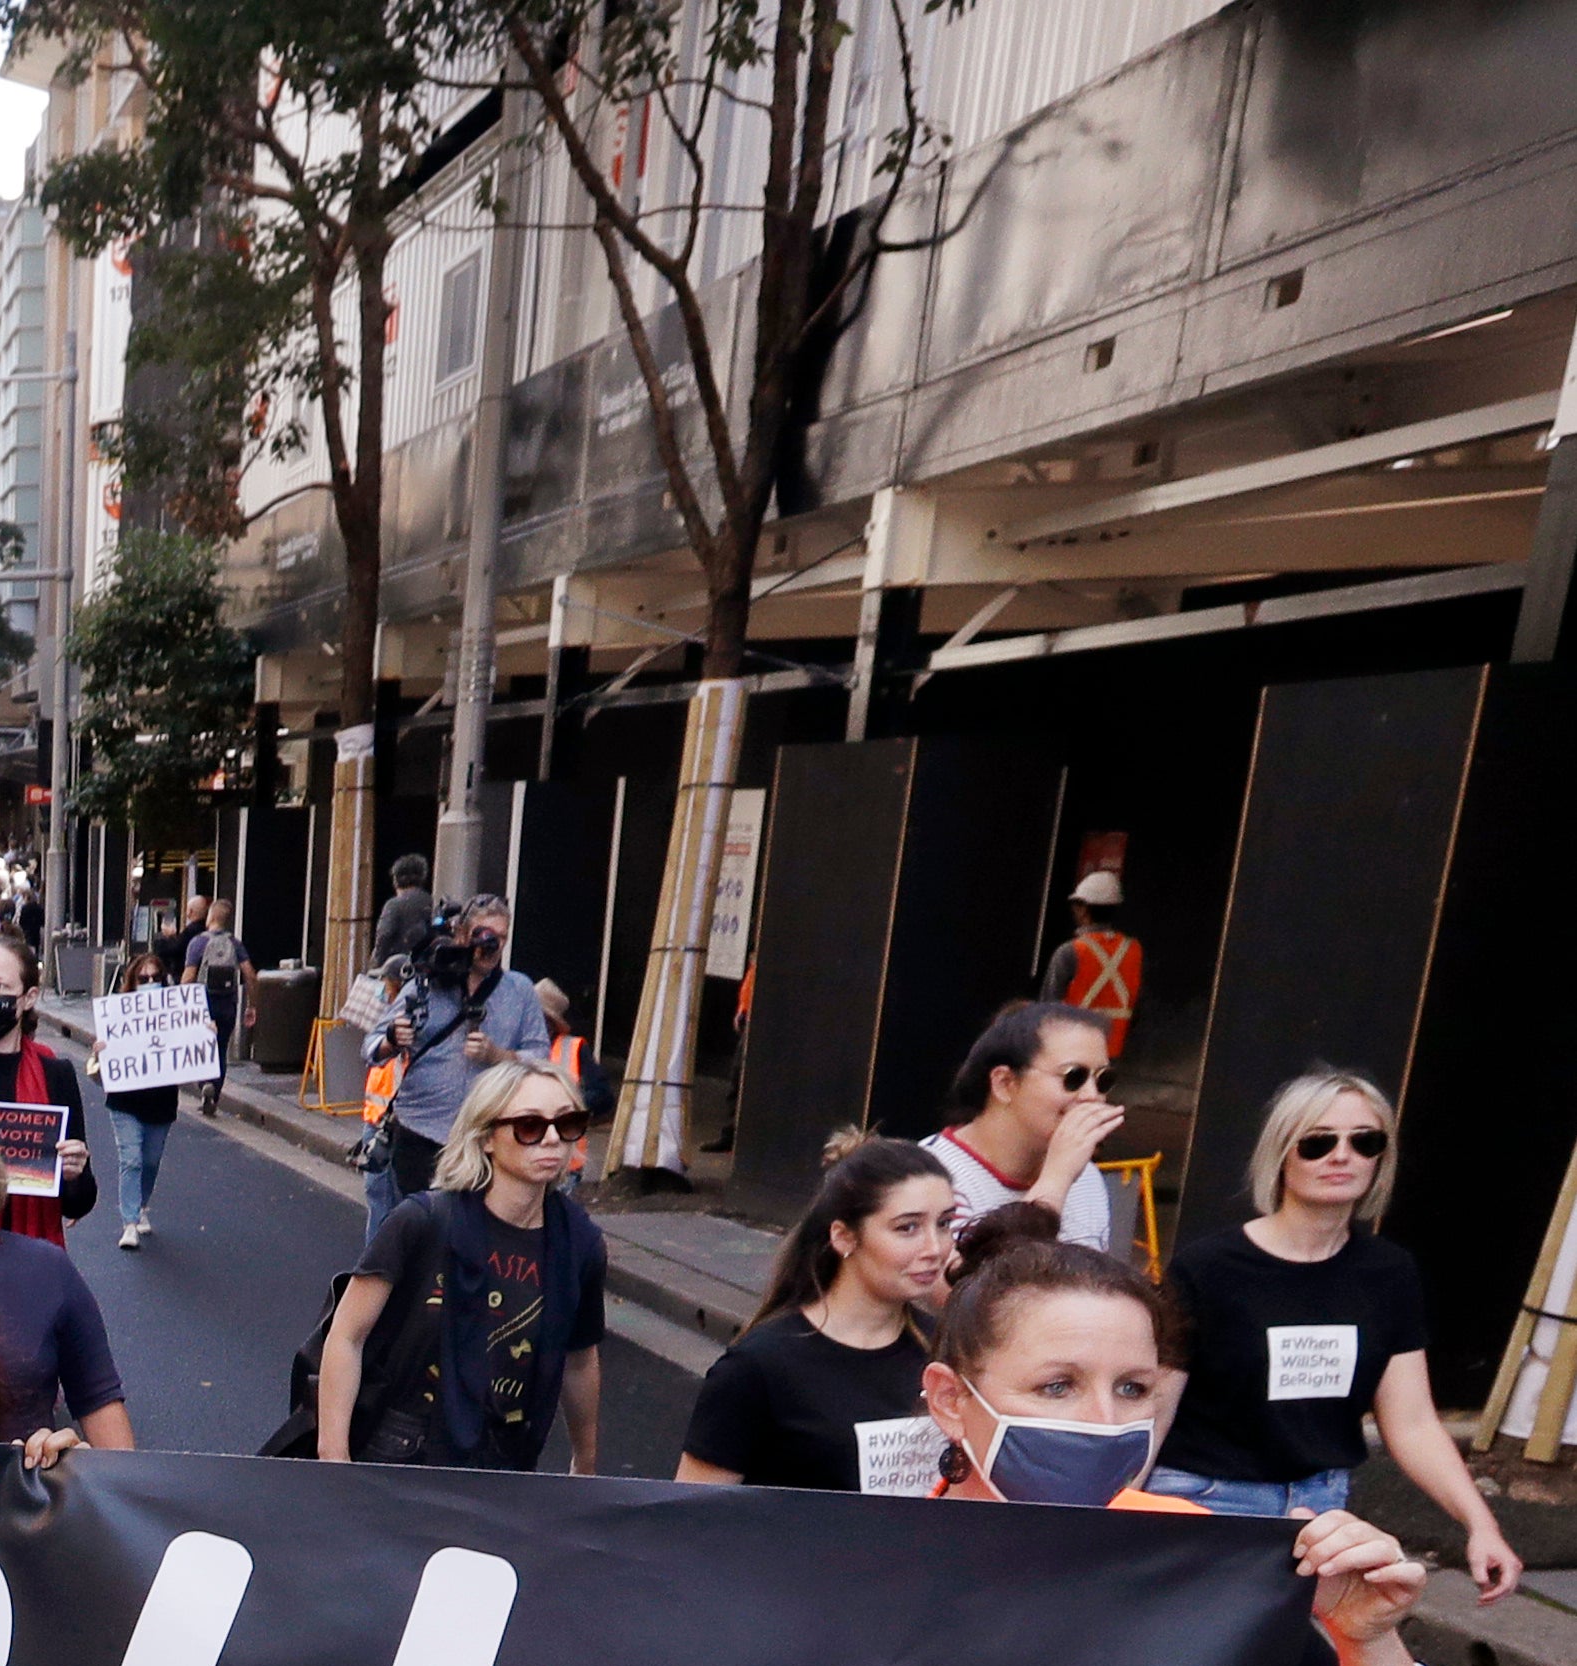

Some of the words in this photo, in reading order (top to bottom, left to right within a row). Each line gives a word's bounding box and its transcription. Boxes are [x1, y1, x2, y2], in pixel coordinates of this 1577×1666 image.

[100, 1000, 110, 1019] I
[120, 984, 205, 1016] BELIEVE
[105, 1008, 211, 1041] KATHERINE
[107, 1039, 217, 1082] BRITTANY
[0, 1128, 44, 1144] VOTE
[487, 1250, 542, 1287] ASTA
[1281, 1336, 1339, 1350] #When
[1281, 1354, 1340, 1368] WillShe
[1279, 1372, 1341, 1388] BeRight
